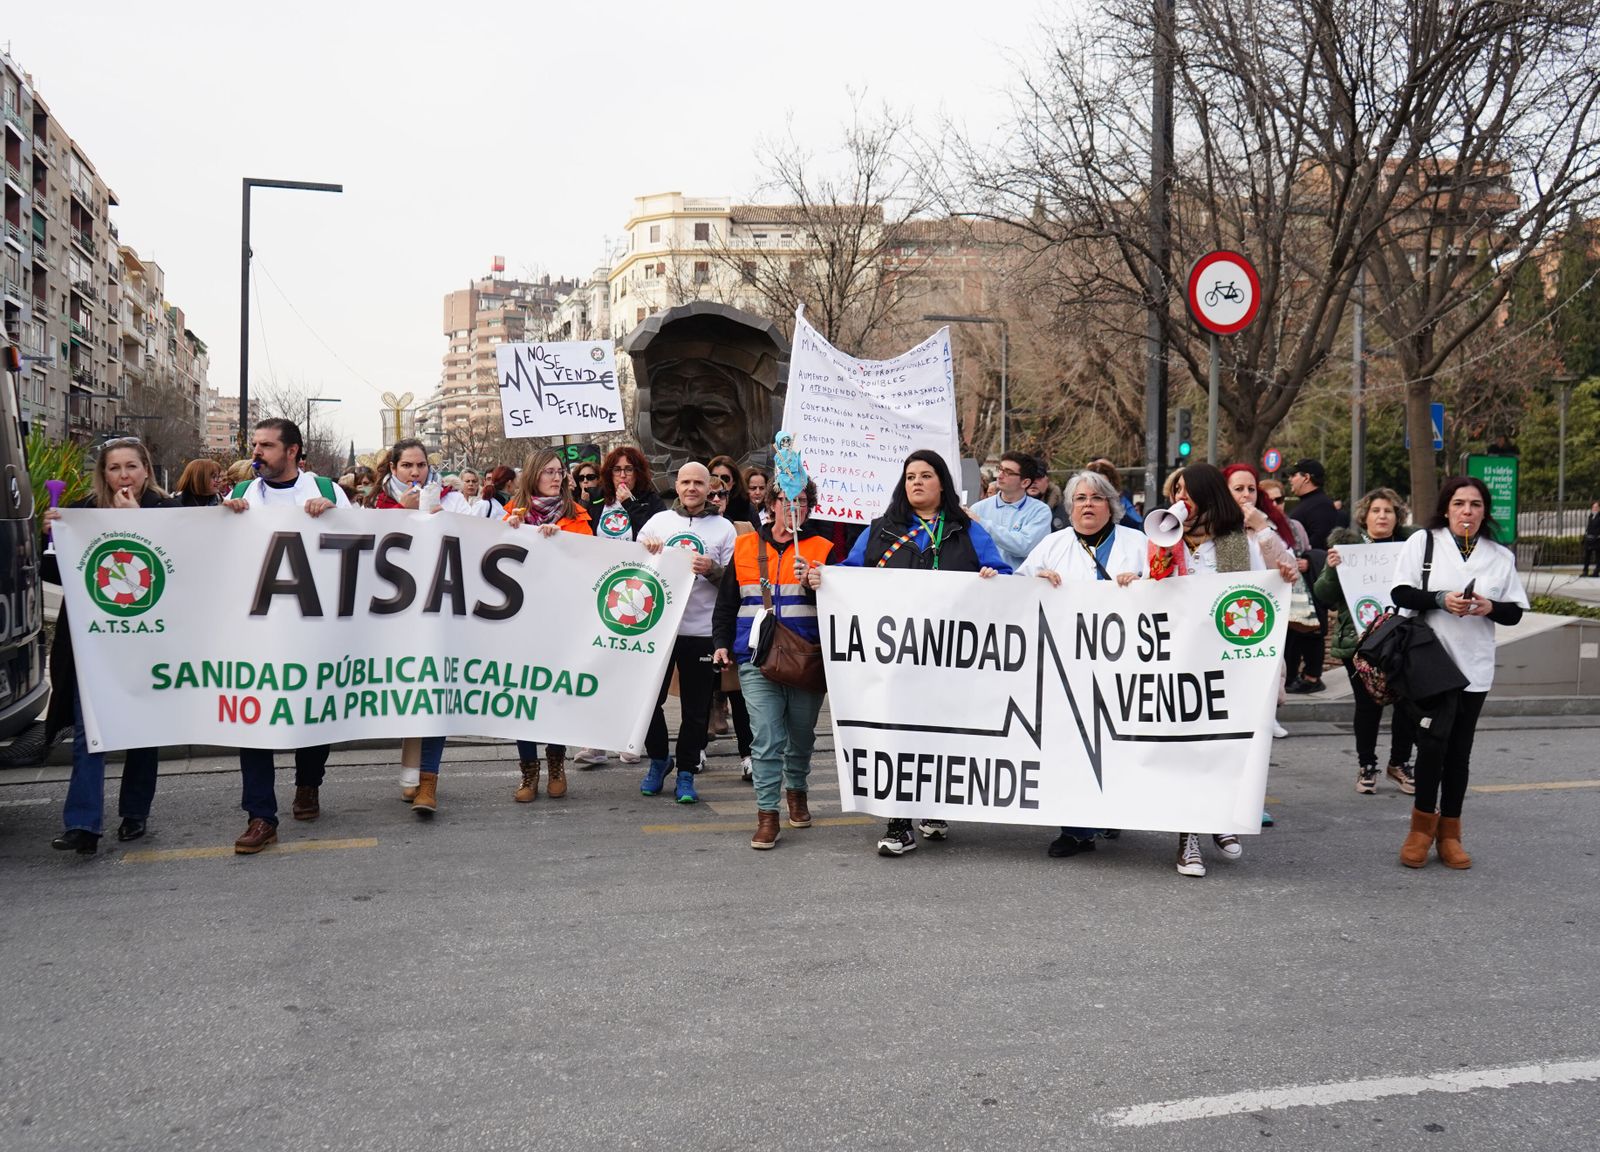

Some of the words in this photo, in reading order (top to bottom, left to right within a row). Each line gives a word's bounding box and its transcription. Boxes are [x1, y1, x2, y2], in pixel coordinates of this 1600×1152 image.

[528, 346, 545, 362] NO
[543, 354, 565, 370] SE
[799, 369, 829, 382] AUMENTO
[809, 384, 857, 397] ATENDIENDO
[891, 385, 945, 399] TRABAJANDO
[509, 409, 534, 427] SE
[545, 393, 617, 424] DEFIENDE
[803, 434, 835, 445] SANIDAD
[880, 444, 910, 454] DIGNA
[804, 447, 835, 457] CALIDAD
[820, 462, 876, 479] BORRASCA
[853, 498, 880, 507] CON
[76, 536, 102, 571] Agrupación
[101, 531, 152, 546] Trabajadores
[155, 546, 167, 557] del
[164, 559, 175, 574] SAS
[1343, 552, 1358, 567] NO
[250, 531, 529, 621] ATSAS
[591, 564, 620, 593] Agrupación
[621, 561, 660, 578] Trabajadores
[661, 578, 669, 590] del
[665, 591, 673, 605] SAS
[1362, 574, 1377, 584] EN
[88, 619, 165, 633] A.T.S.A.S
[592, 635, 655, 654] A.T.S.A.S
[829, 614, 866, 663] LA
[874, 615, 1027, 673] SANIDAD
[1075, 611, 1126, 661] NO
[1136, 612, 1171, 663] SE
[1221, 646, 1276, 660] A.T.S.A.S
[151, 660, 307, 691] SANIDAD
[316, 654, 439, 689] PÚBLICA
[444, 656, 458, 683] DE
[463, 658, 599, 697] CALIDAD
[218, 694, 261, 724] NO
[269, 697, 294, 725] A
[304, 695, 337, 724] LA
[344, 687, 538, 721] PRIVATIZACIÓN
[1115, 670, 1229, 723] VENDE
[844, 748, 869, 797] E
[873, 749, 1041, 810] DEFIENDE
